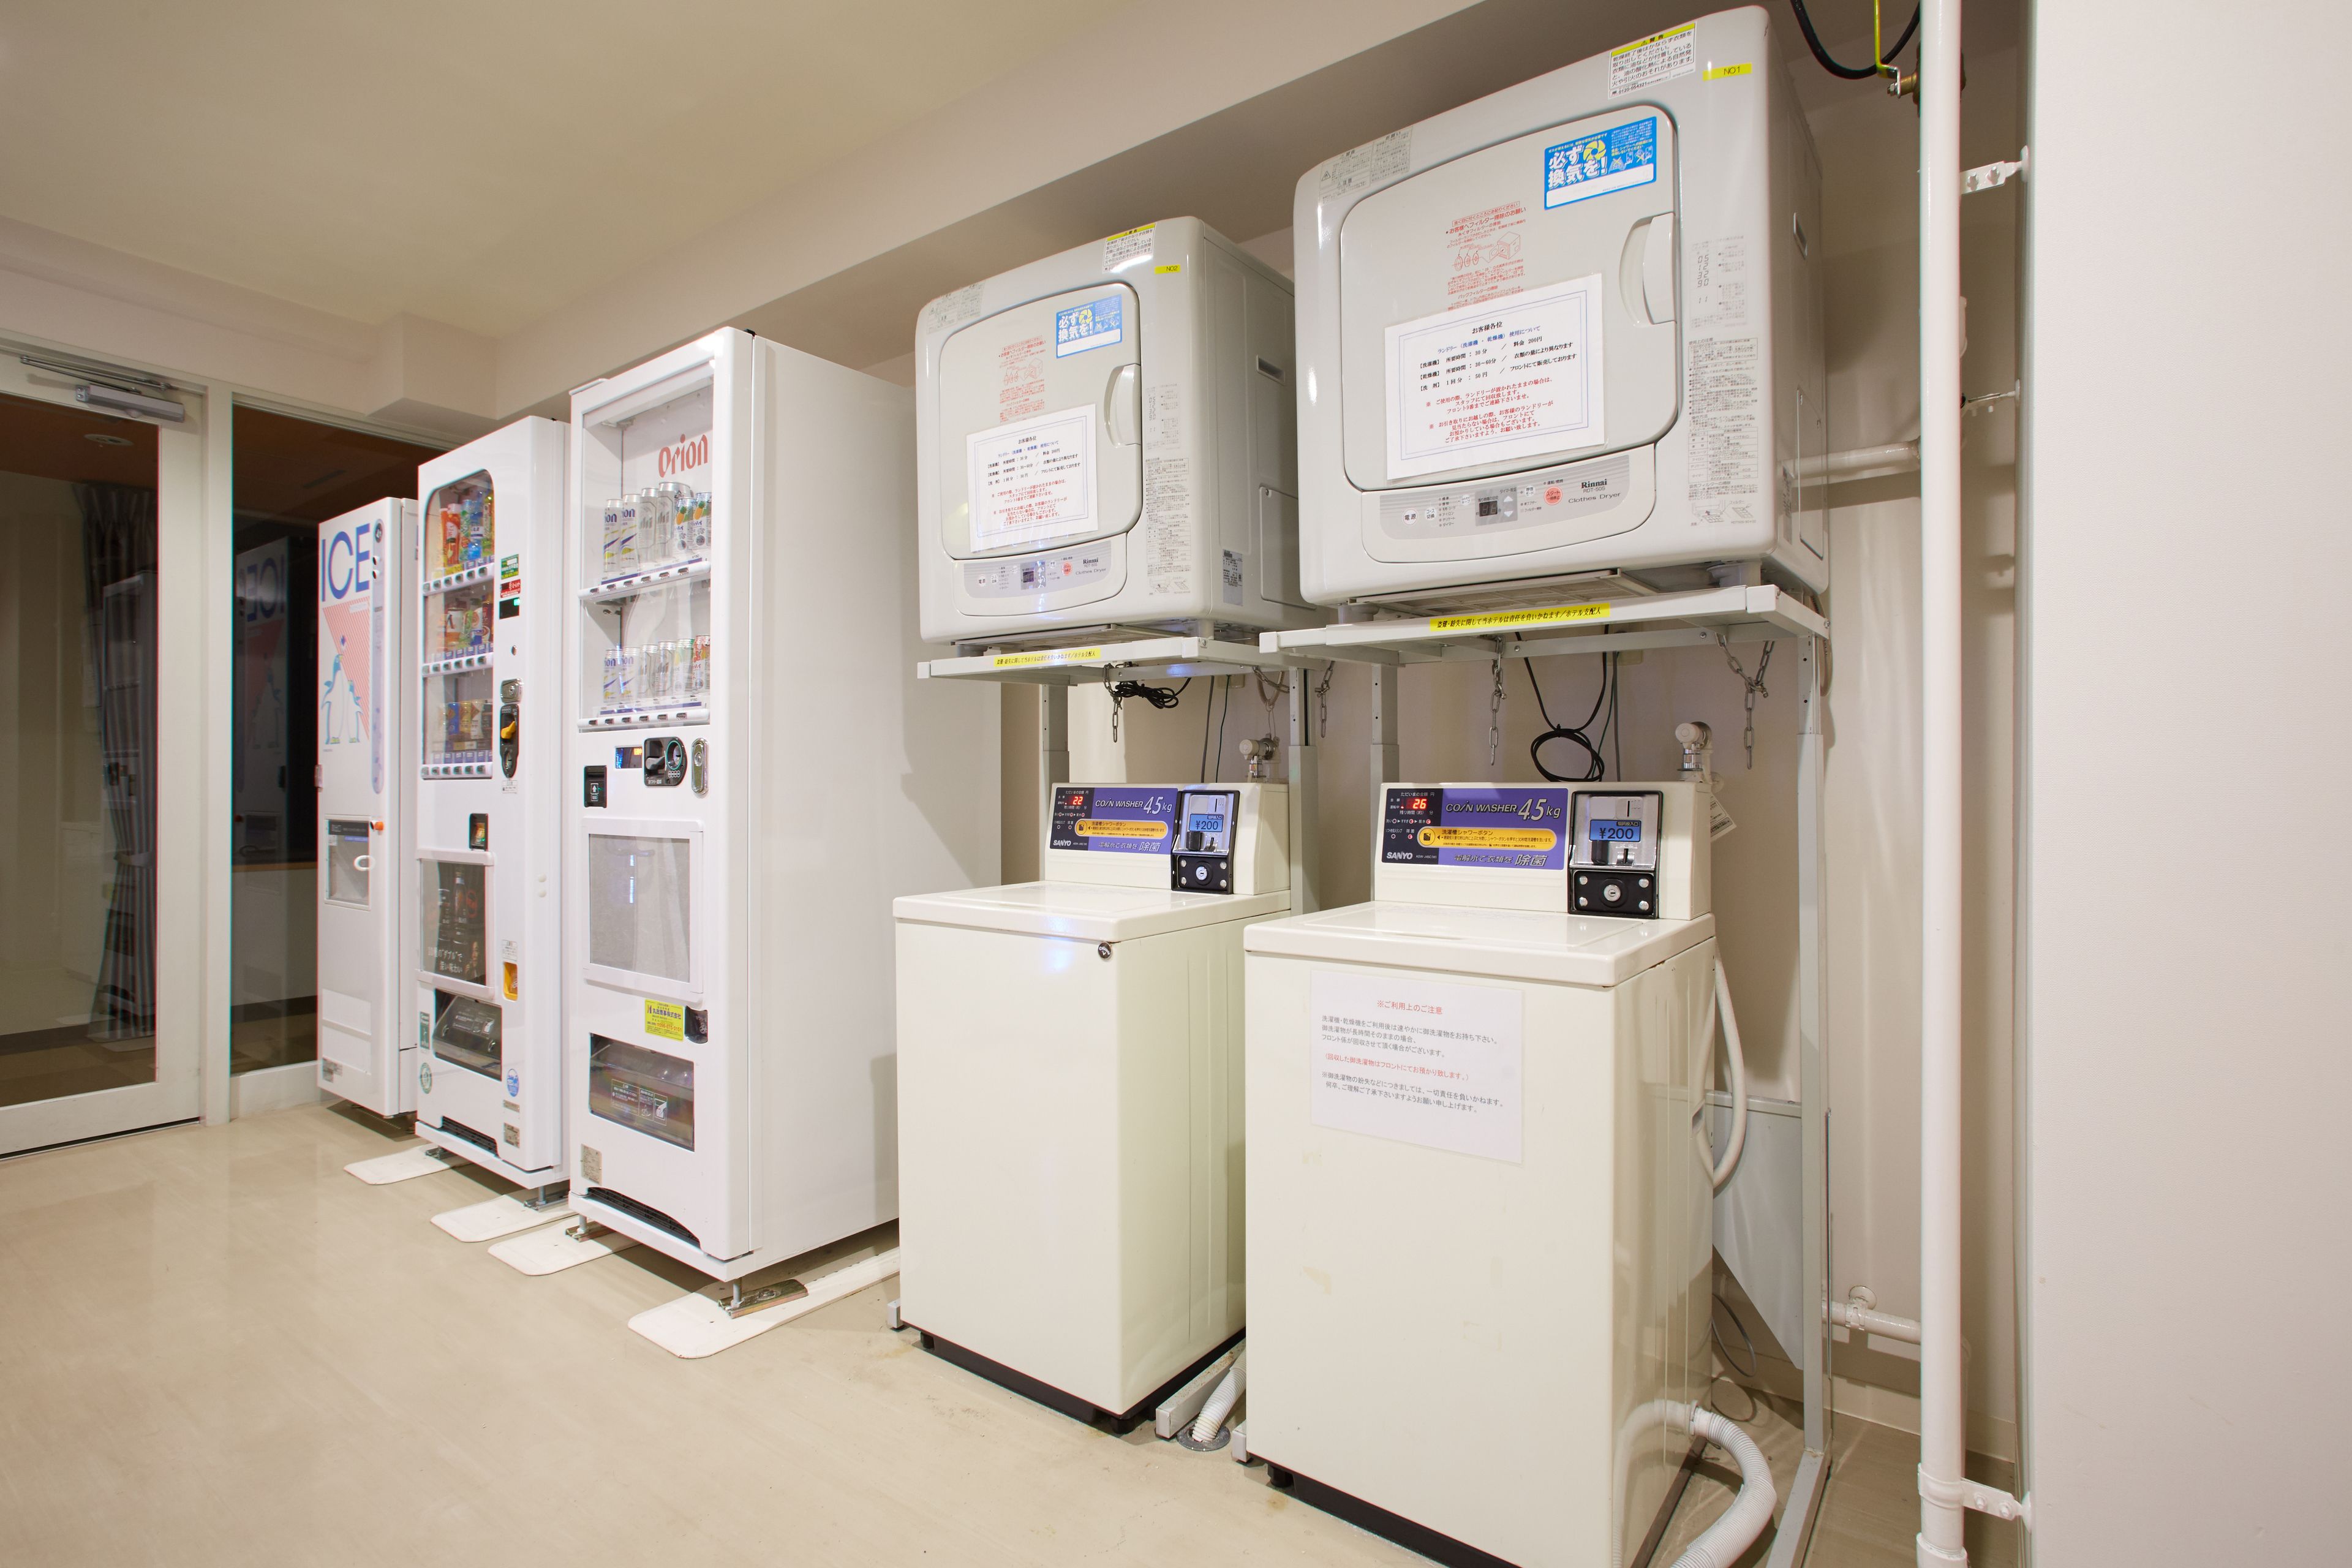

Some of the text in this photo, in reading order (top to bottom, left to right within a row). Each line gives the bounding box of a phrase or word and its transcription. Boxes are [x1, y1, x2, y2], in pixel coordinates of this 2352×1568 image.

[1724, 66, 1740, 75] NO1
[1549, 145, 1584, 170] 必ず
[1472, 322, 1502, 334] お客様各位
[1581, 479, 1607, 489] Rinnai
[605, 514, 617, 522] ion
[621, 508, 635, 518] ion
[322, 523, 371, 602] ICE
[1073, 796, 1083, 805] 22
[1413, 799, 1427, 809] 26
[1446, 800, 1474, 813] COIN
[1476, 804, 1517, 813] WASHER
[1196, 820, 1218, 830] ¥200
[1599, 828, 1634, 839] ¥200
[1515, 854, 1548, 866] 除菌
[1377, 1000, 1442, 1015] ※ご利用上のご注意
[1322, 1025, 1416, 1044] 御洗濯物が長時間そのままの場合、
[1322, 1035, 1445, 1057] フロント係が回収させて頂く場合がございます。
[1322, 1071, 1503, 1107] ※御洗濯物の紛失などにつきましては、一切責任を負いかねます。
[1326, 1081, 1477, 1113] 何卒、ご理解ご了承下さいますようお願い申し上げます。
